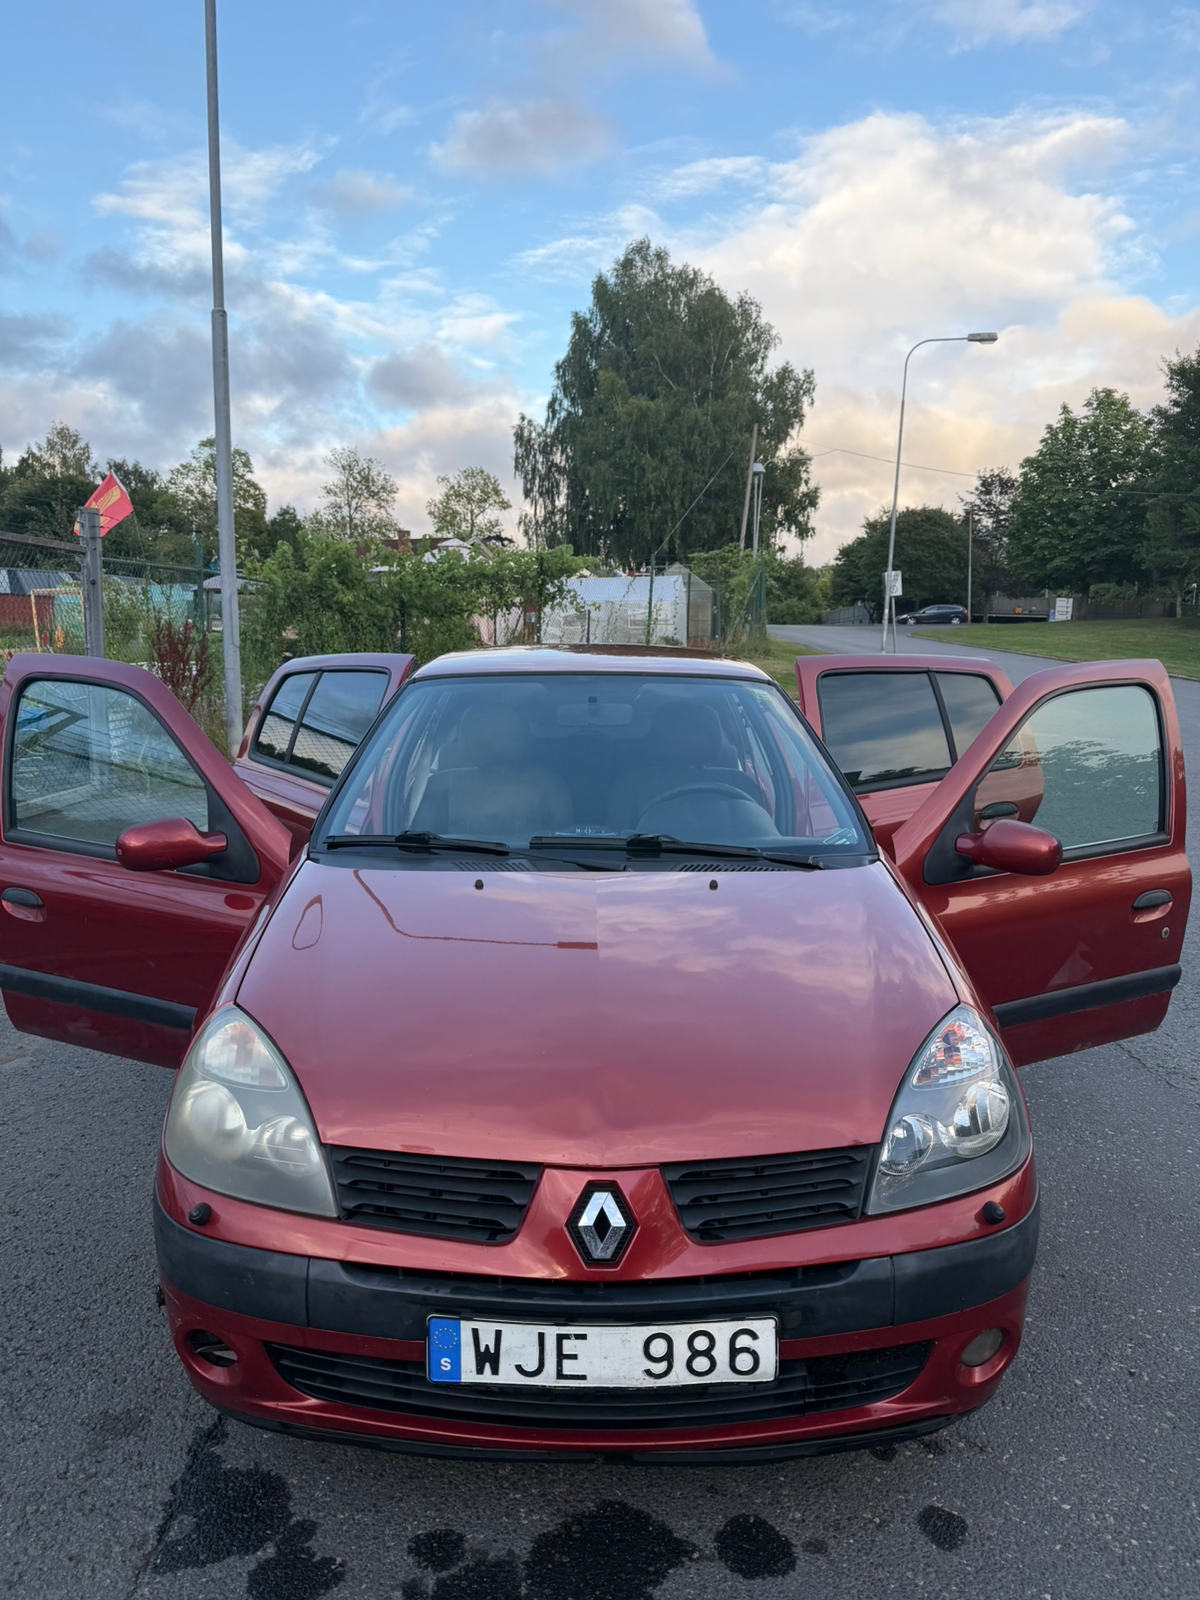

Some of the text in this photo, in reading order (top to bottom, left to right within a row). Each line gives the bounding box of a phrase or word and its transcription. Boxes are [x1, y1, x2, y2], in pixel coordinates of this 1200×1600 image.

[440, 1357, 452, 1371] S
[471, 1328, 760, 1381] WJE 986
